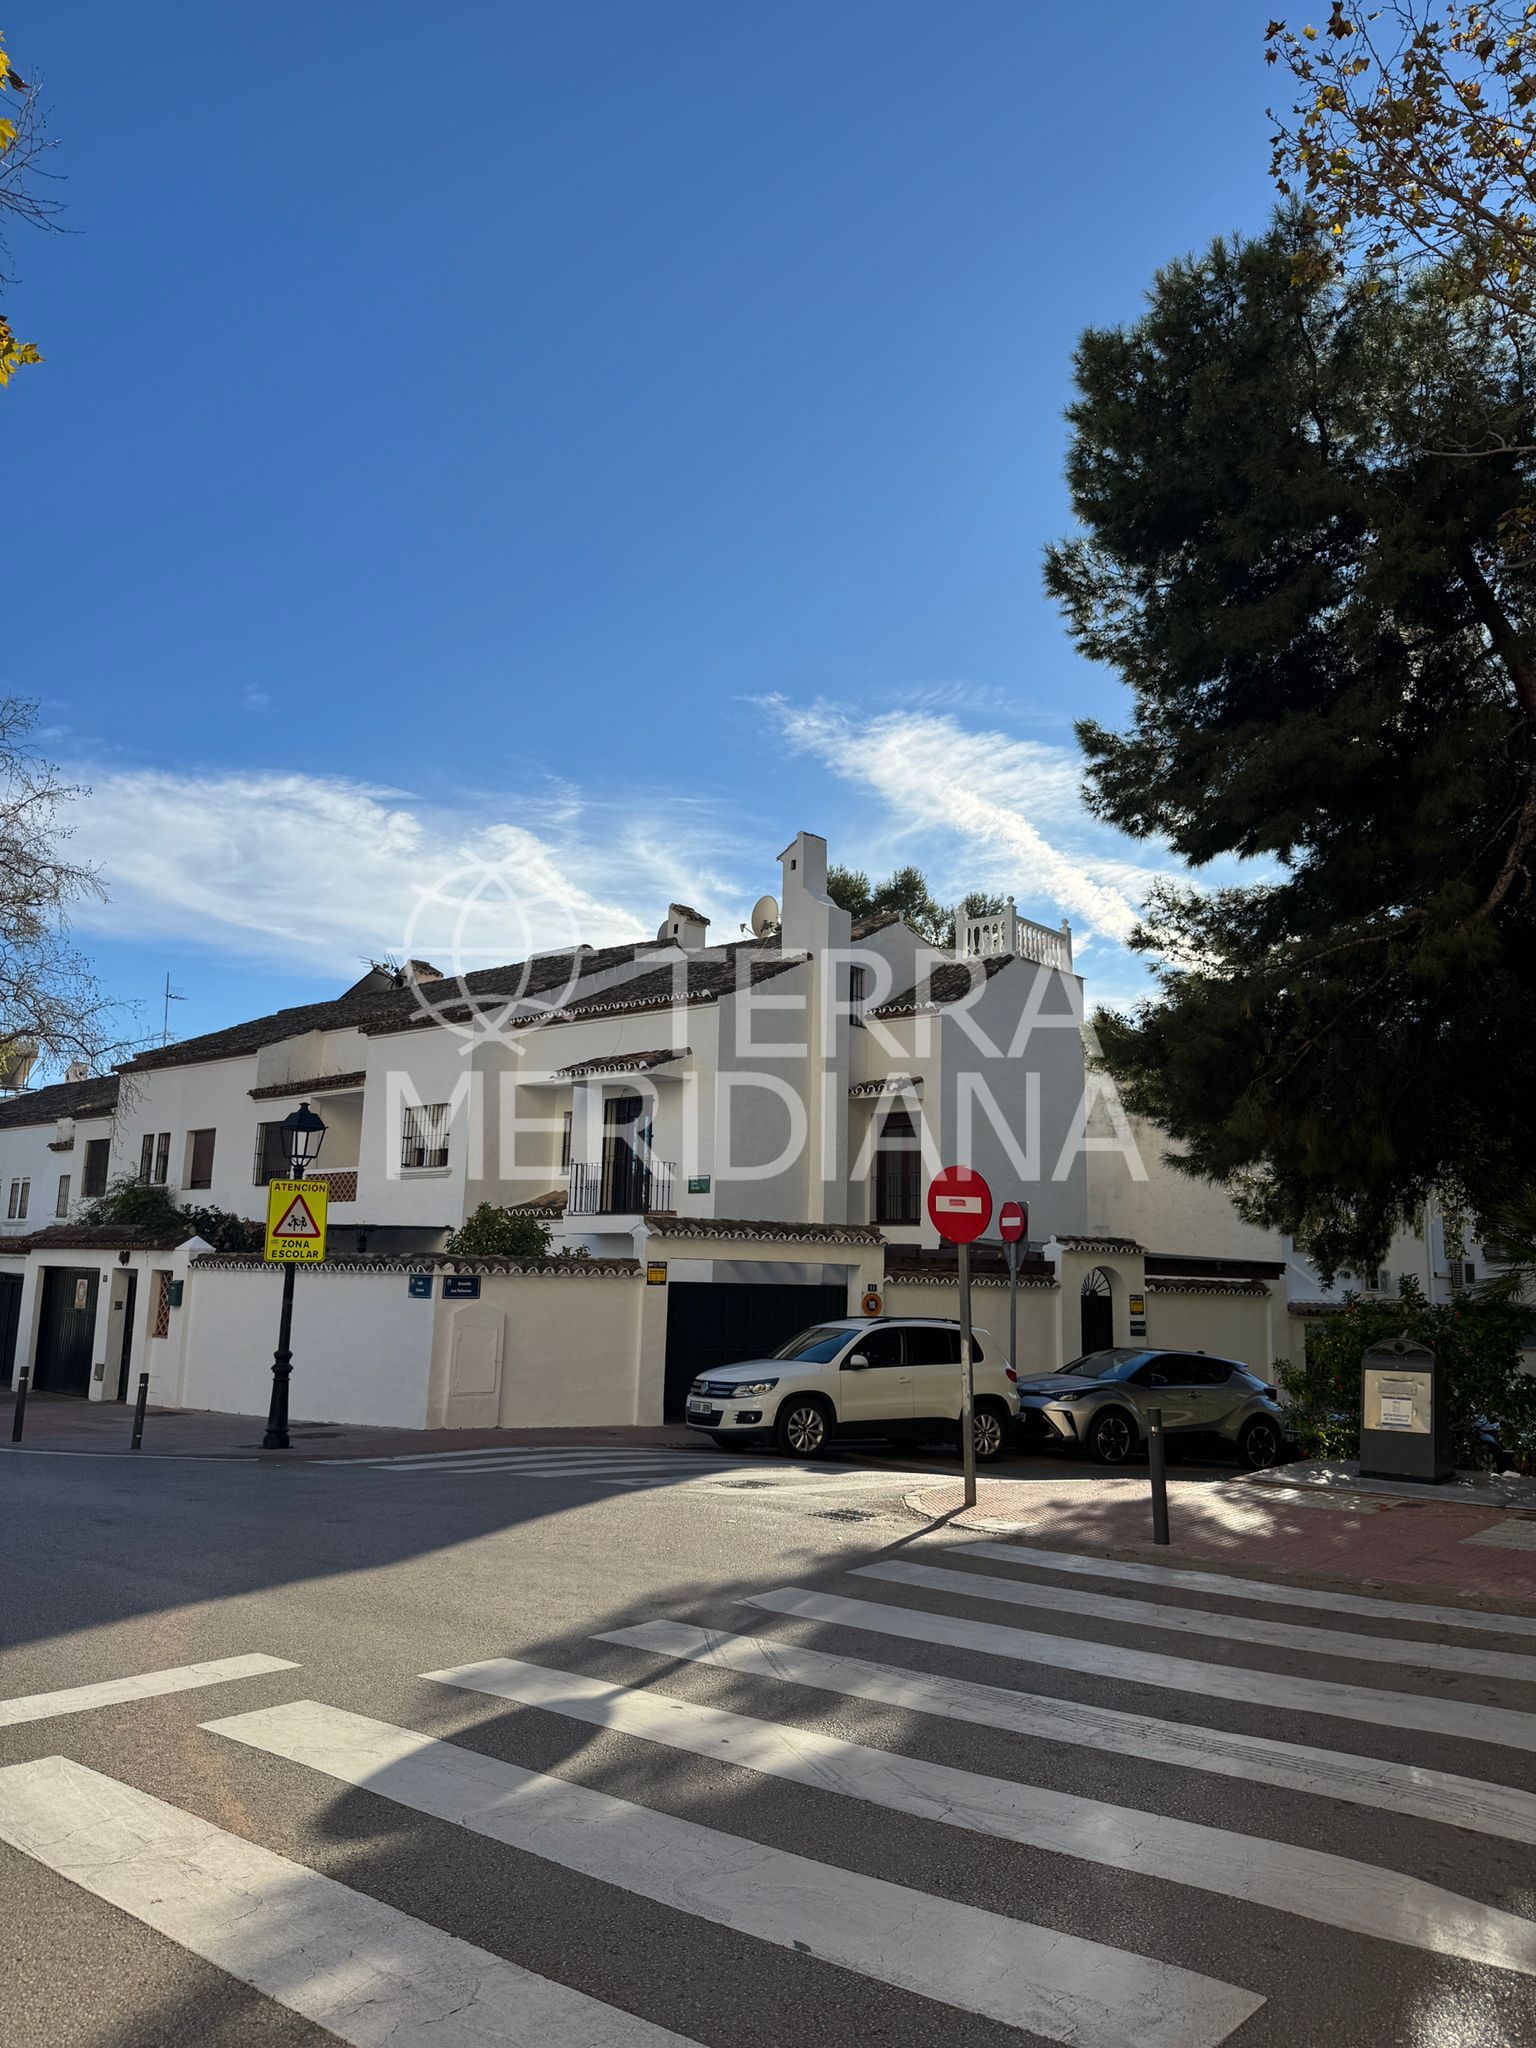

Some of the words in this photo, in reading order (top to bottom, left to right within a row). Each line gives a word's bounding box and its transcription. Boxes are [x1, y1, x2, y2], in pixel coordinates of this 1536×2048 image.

[274, 1183, 326, 1192] ATENCIÓN
[281, 1240, 310, 1249] ZONA
[271, 1250, 319, 1259] ESCOLAR
